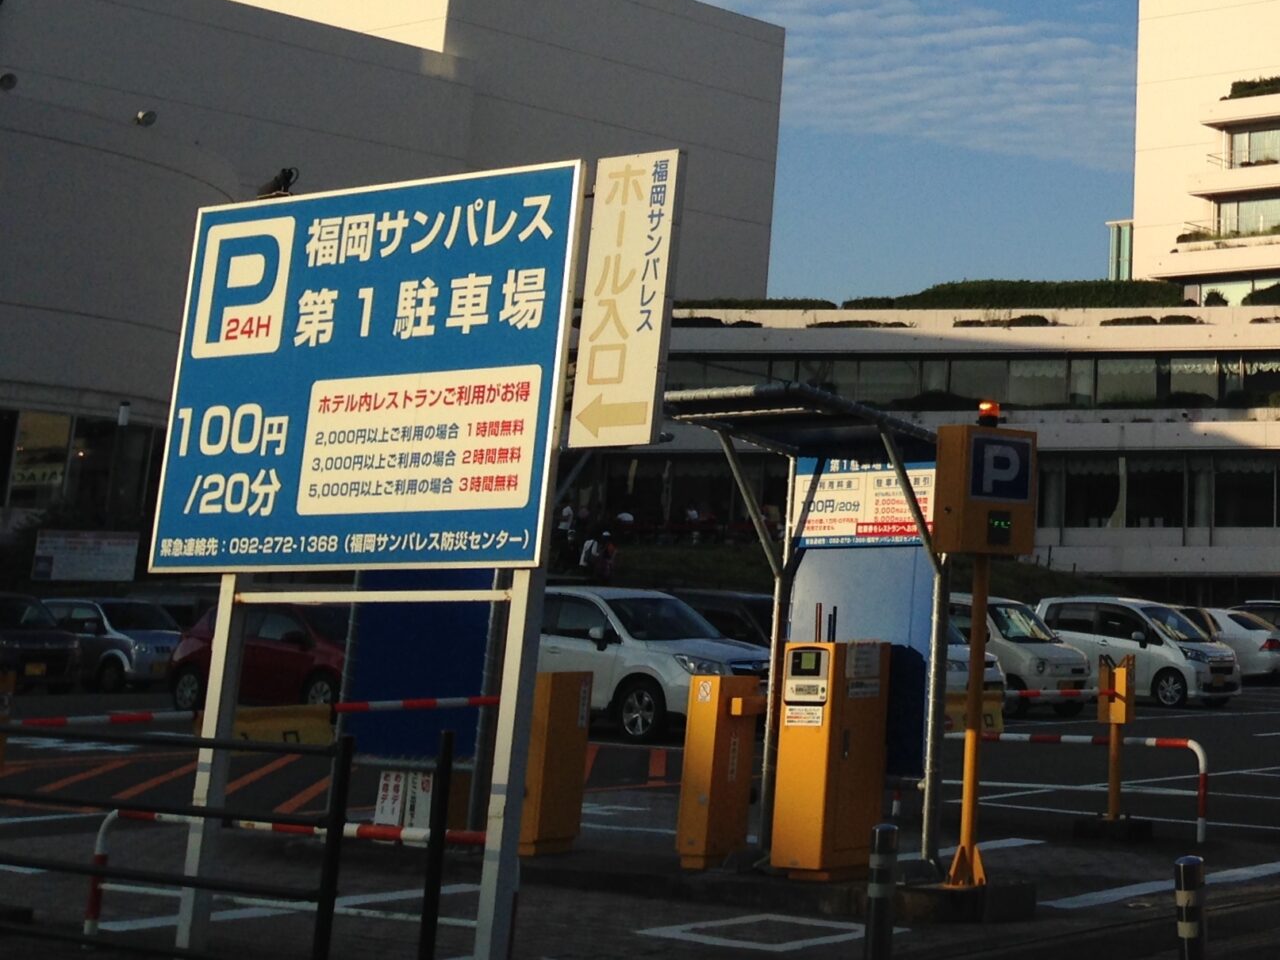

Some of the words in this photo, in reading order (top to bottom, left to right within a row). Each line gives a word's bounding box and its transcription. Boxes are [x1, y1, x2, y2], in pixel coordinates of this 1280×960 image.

[305, 194, 553, 268] 福岡サンパレス
[636, 159, 669, 332] 福岡サンパレス
[587, 164, 647, 385] ホール入口
[225, 315, 272, 341] 24H
[318, 381, 531, 414] ホテル内レストランご利用がお得
[178, 403, 289, 456] 100円
[315, 423, 459, 447] 2,000円以上ご利用の場合
[466, 419, 525, 437] 1時間無料
[312, 450, 456, 472] 3,000円以上ご利用の場合
[462, 446, 521, 465] 2時間無料
[982, 444, 1020, 493] P
[183, 468, 281, 517] /20分
[308, 477, 453, 499] 5,000円以上ご利用の場合
[459, 474, 518, 493] 3時間無料
